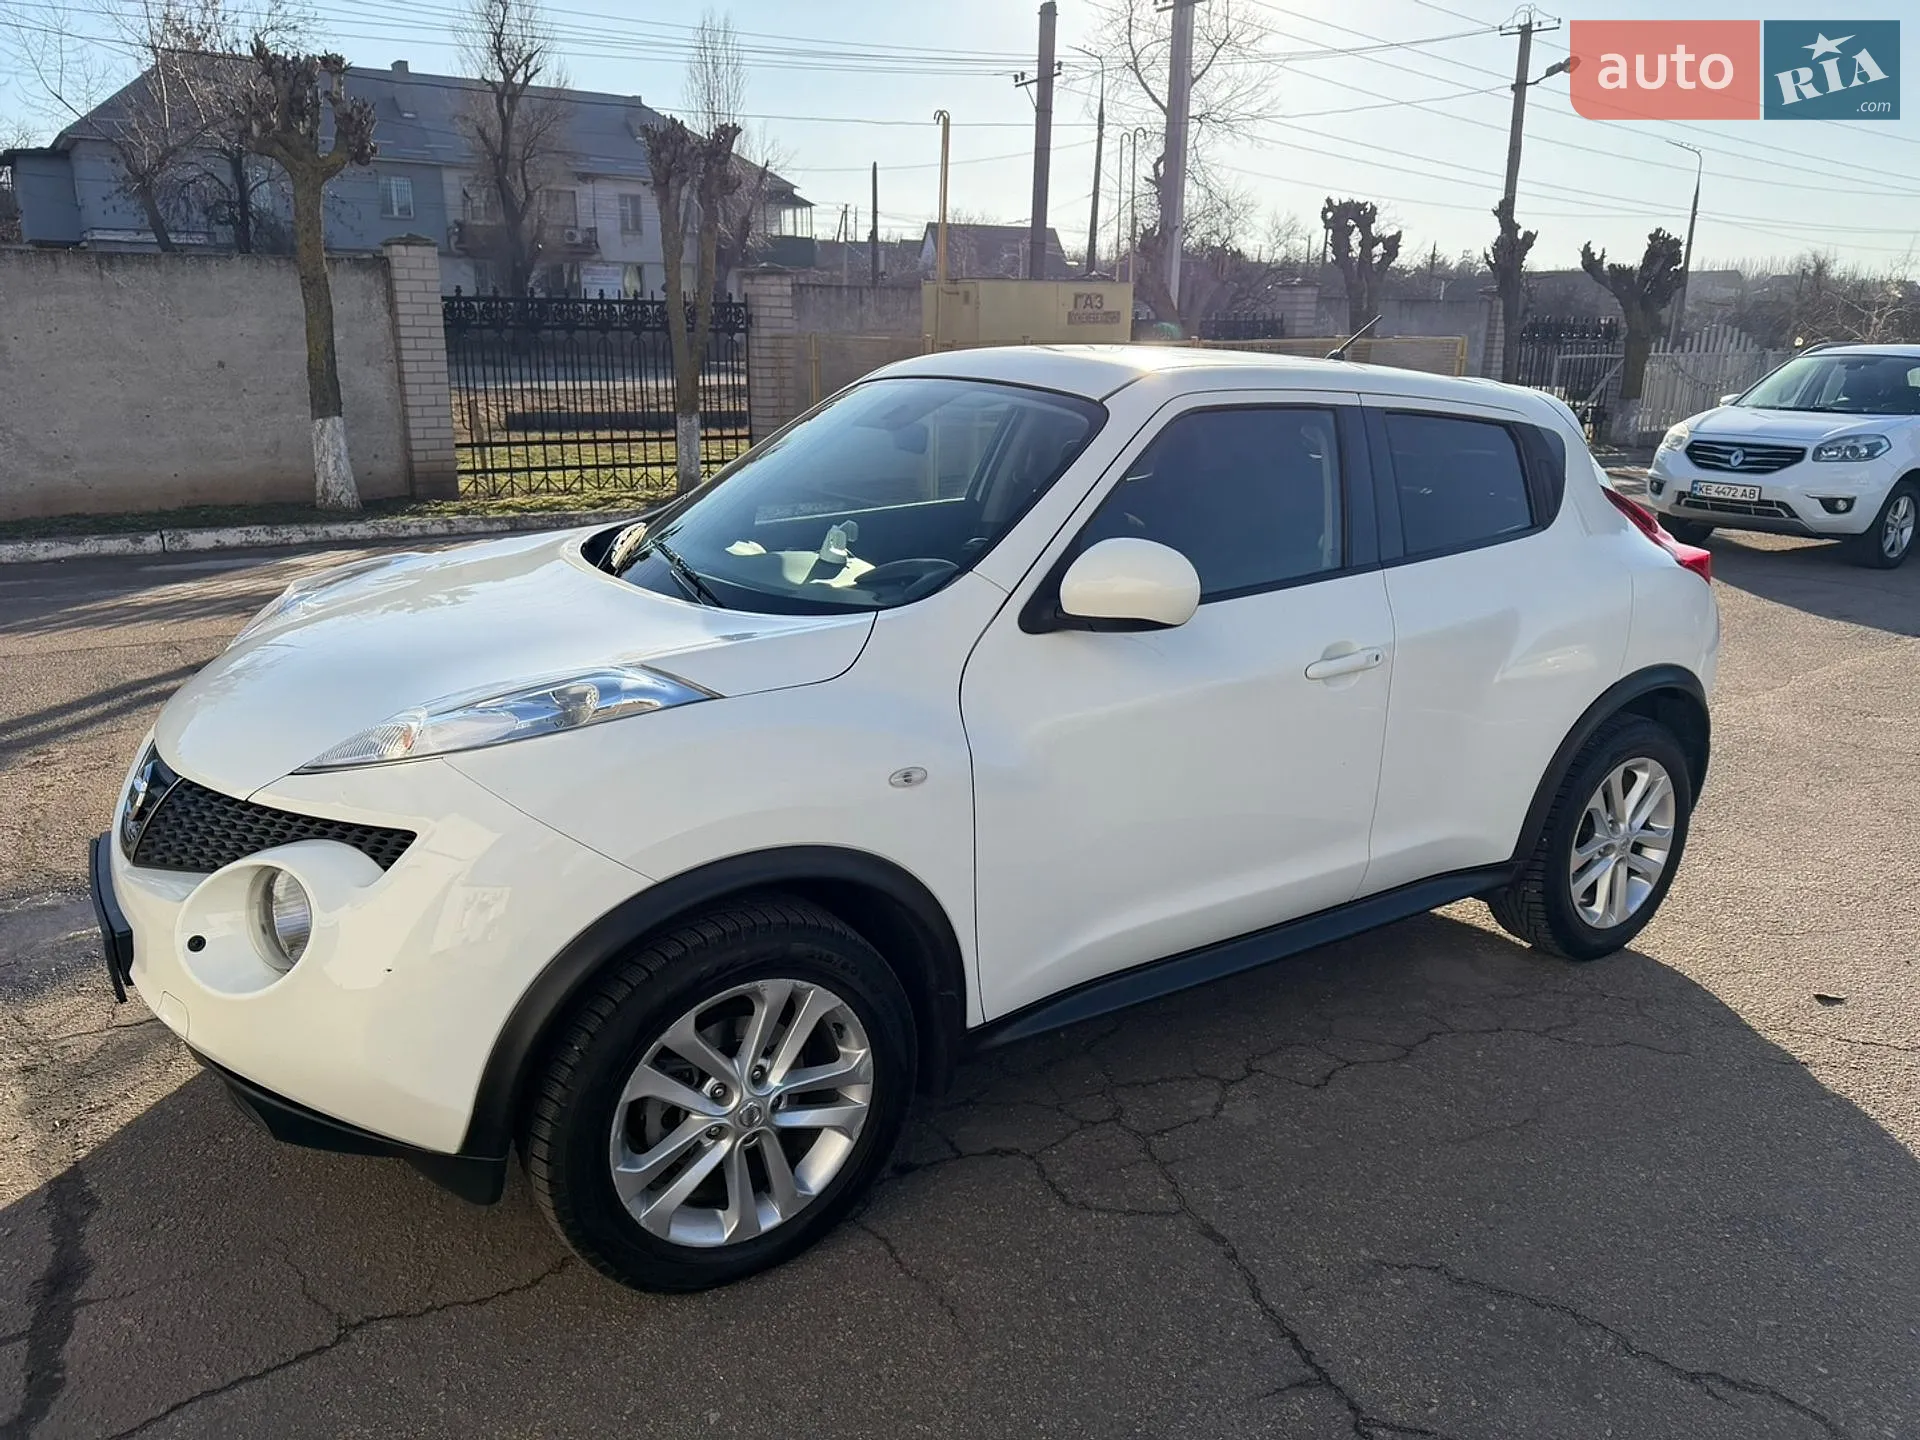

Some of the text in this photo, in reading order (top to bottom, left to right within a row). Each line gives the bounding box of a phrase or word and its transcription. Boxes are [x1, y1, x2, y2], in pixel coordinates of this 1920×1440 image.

[1073, 293, 1104, 310] ГАЗ
[1699, 484, 1756, 499] KE 4472 AB
